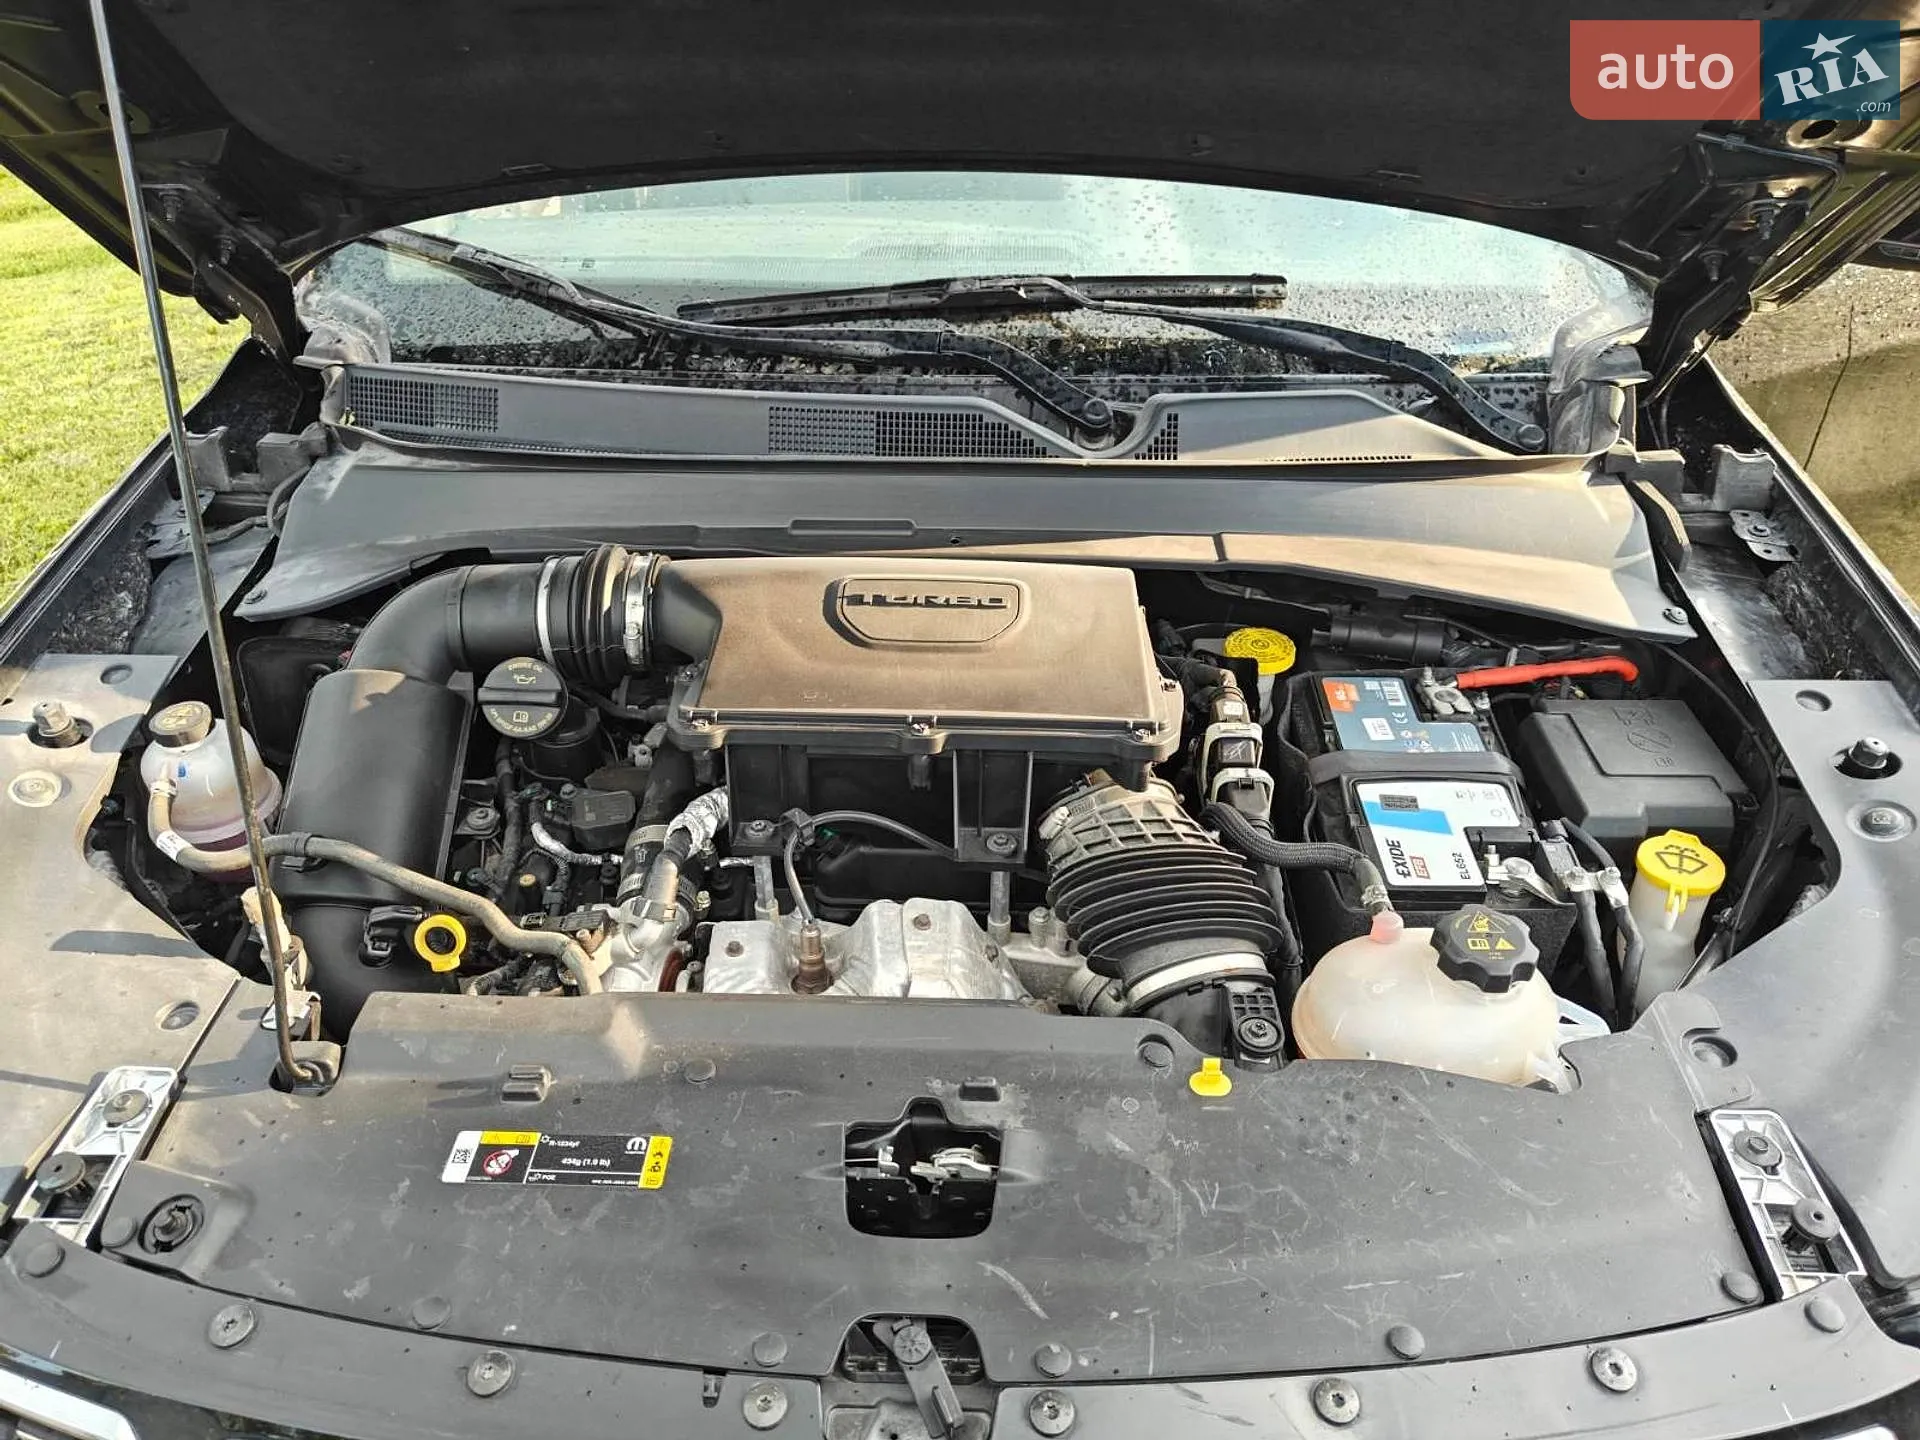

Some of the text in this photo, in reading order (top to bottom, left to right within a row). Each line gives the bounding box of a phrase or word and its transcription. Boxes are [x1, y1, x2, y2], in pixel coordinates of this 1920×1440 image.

[847, 592, 1007, 608] TURBO
[1385, 838, 1412, 878] EXIDE
[1452, 852, 1471, 880] EL652
